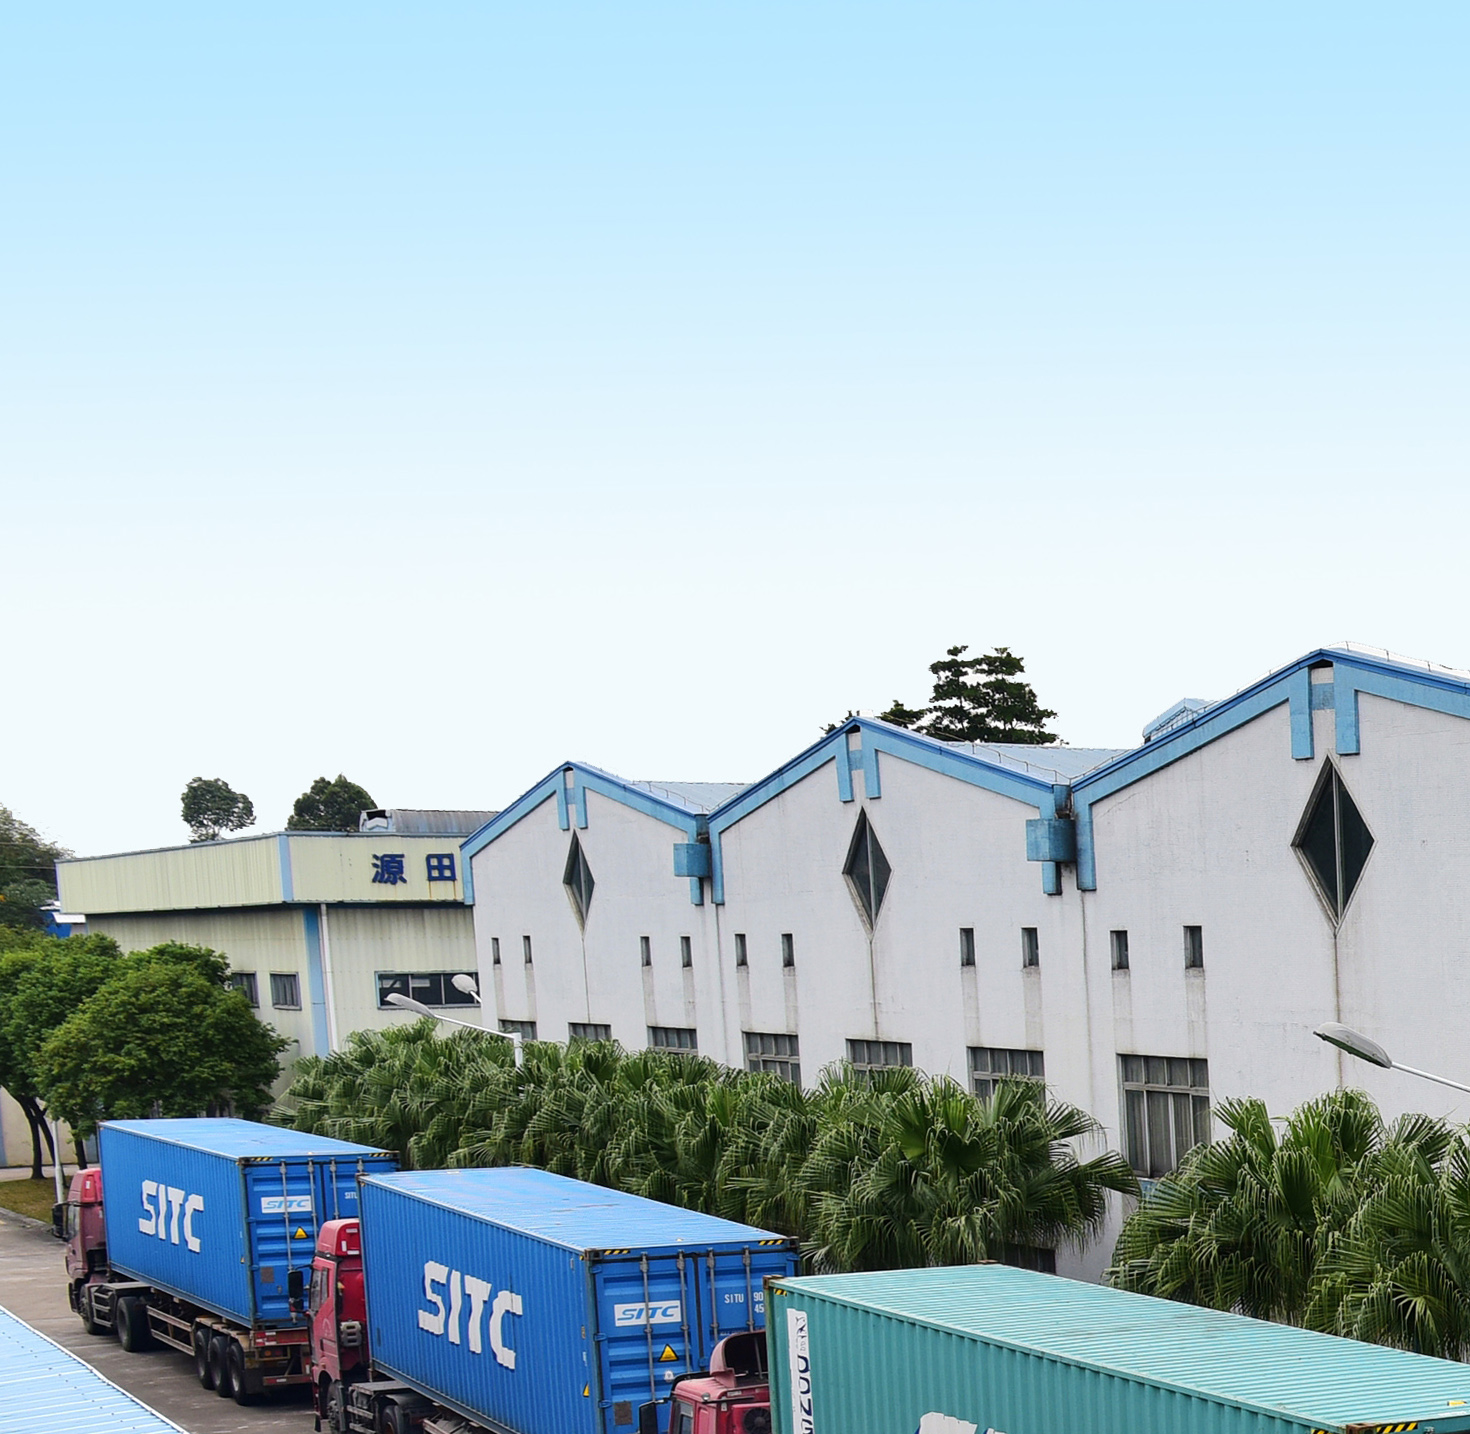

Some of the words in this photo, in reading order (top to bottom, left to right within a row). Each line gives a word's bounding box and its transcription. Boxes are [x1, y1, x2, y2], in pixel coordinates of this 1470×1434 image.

[371, 853, 457, 885] 源田
[263, 1198, 310, 1210] SITC
[138, 1179, 204, 1254] SITC
[724, 1293, 744, 1304] SITU
[417, 1261, 523, 1370] SITC
[617, 1305, 679, 1321] SITC
